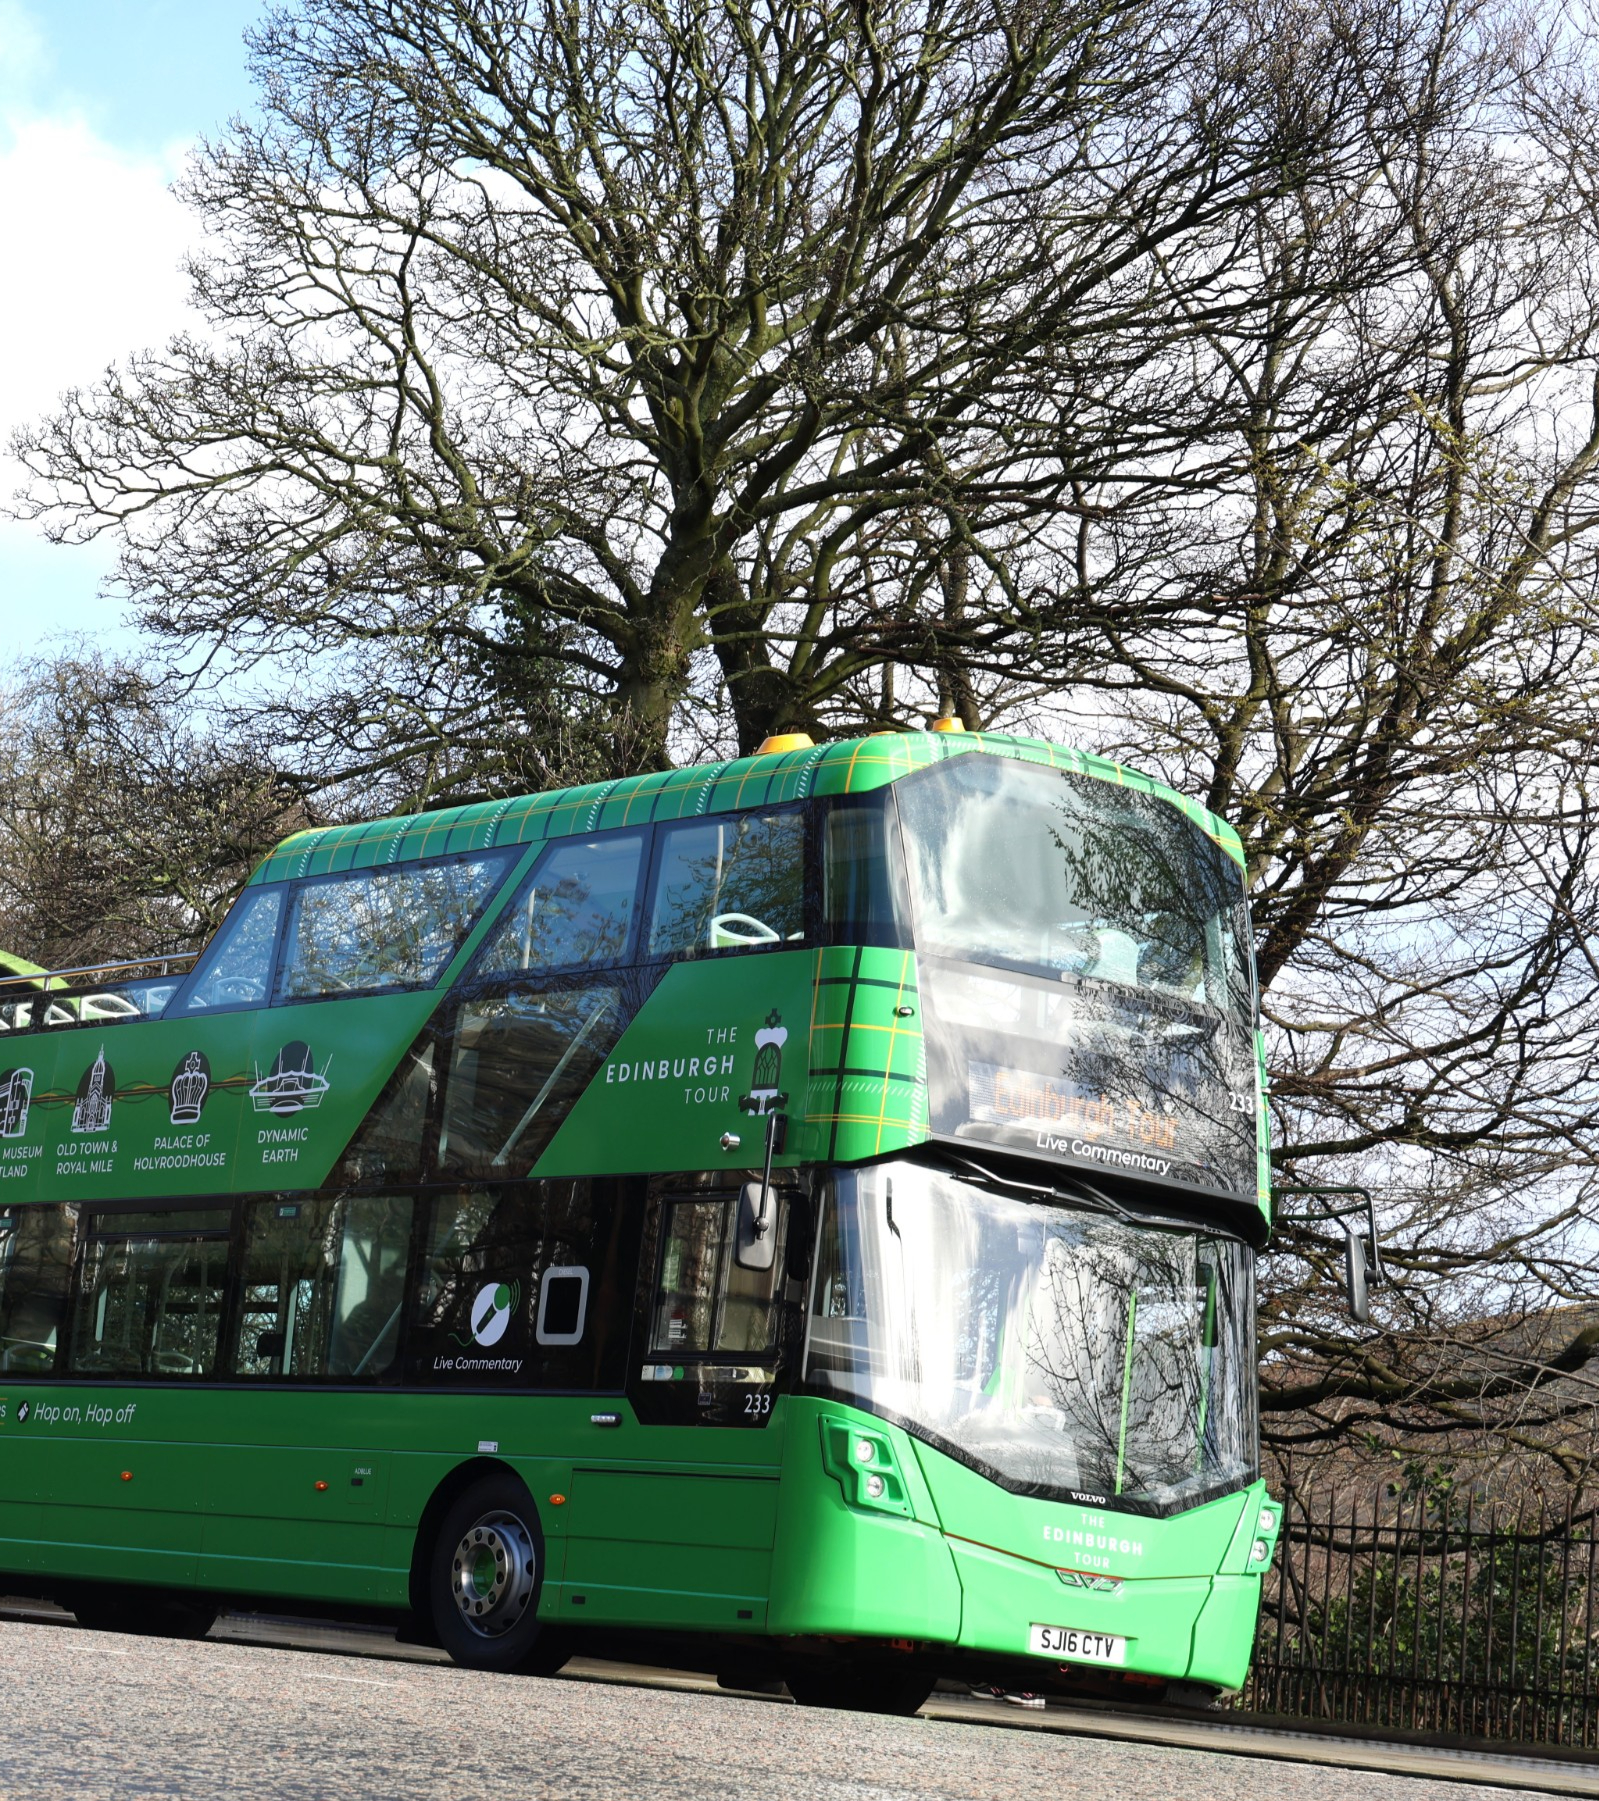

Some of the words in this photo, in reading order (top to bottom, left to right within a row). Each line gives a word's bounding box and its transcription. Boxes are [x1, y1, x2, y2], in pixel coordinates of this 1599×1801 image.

[707, 1026, 738, 1045] THE
[605, 1054, 735, 1083] EDINBURGH
[684, 1086, 730, 1104] TOUR
[1228, 1091, 1254, 1115] 233
[153, 1135, 193, 1150] PALACE
[195, 1133, 211, 1148] OF
[257, 1127, 309, 1144] DYNAMIC
[2, 1145, 43, 1160] MUSEUM
[56, 1143, 77, 1157] OLD
[79, 1140, 110, 1155] TOWN
[111, 1140, 118, 1153] &
[261, 1148, 299, 1164] EARTH
[1036, 1131, 1068, 1152] Live
[1071, 1139, 1172, 1176] Commentary
[56, 1161, 87, 1175] ROYAL
[89, 1159, 114, 1173] MILE
[133, 1153, 227, 1171] HOLYROODHOUSE
[432, 1355, 454, 1370] Live
[455, 1356, 523, 1374] Commentary
[743, 1393, 771, 1414] 233
[33, 1402, 60, 1425] Hop
[62, 1406, 82, 1425] on,
[85, 1403, 113, 1427] Hop
[115, 1403, 137, 1424] off
[1070, 1491, 1106, 1505] VOLVO
[1081, 1513, 1106, 1529] THE
[1043, 1526, 1143, 1556] EDINBURGH
[1074, 1551, 1110, 1569] TOUR
[1040, 1628, 1078, 1653] SJ16
[1082, 1634, 1115, 1658] CTV
